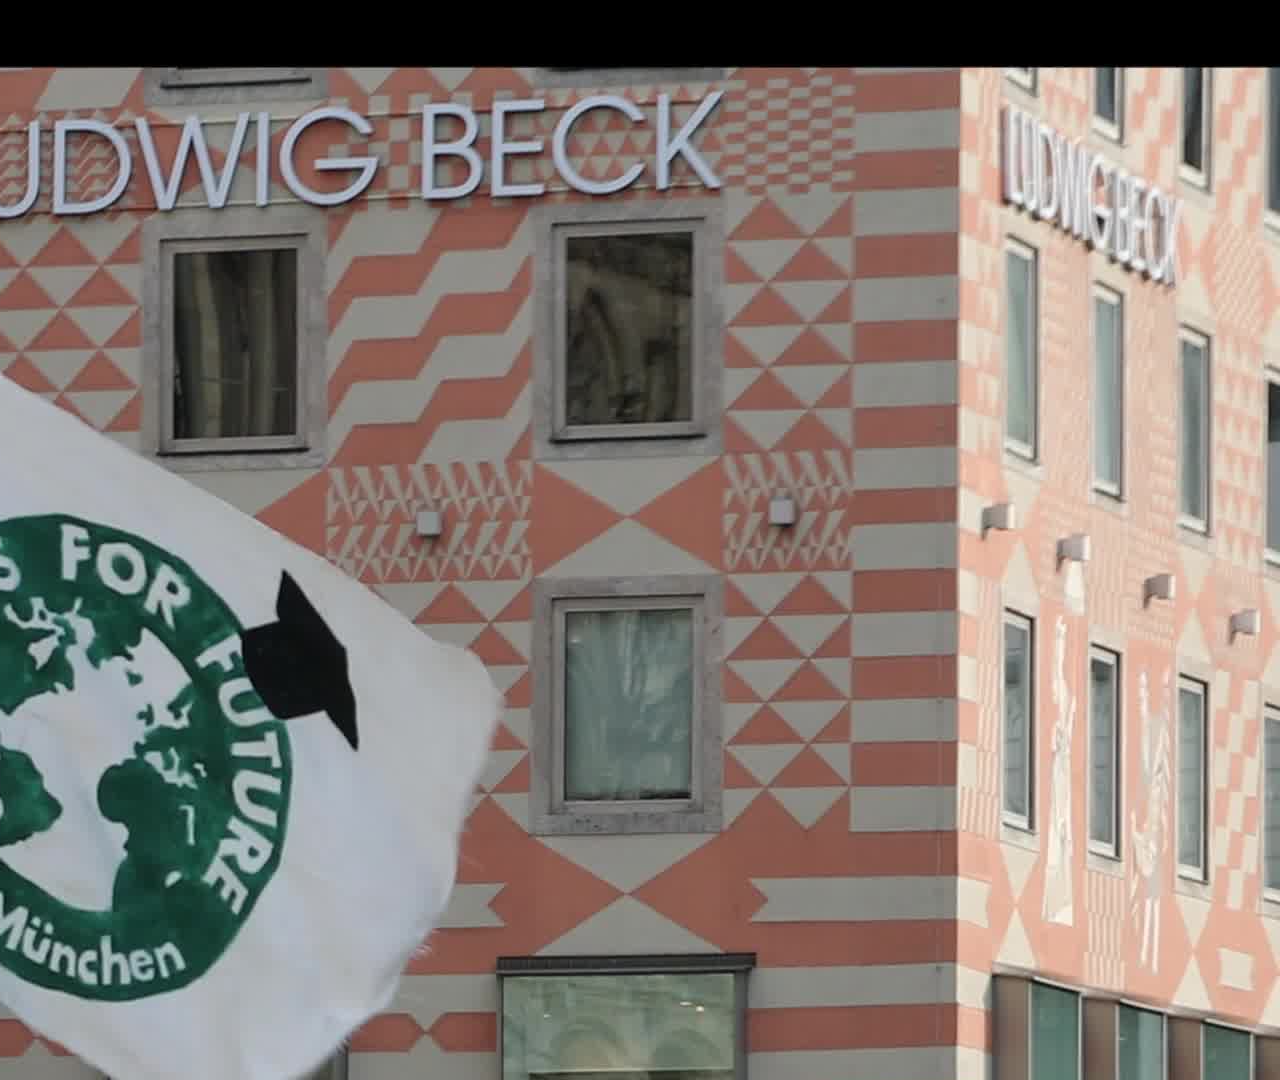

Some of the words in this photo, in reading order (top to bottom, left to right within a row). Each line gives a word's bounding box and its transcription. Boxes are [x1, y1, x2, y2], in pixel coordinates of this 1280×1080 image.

[420, 90, 725, 201] BECK
[1002, 104, 1111, 250] LUDWIG
[1111, 166, 1183, 289] BECK
[60, 523, 192, 630] FOR
[196, 632, 284, 914] FUTURE
